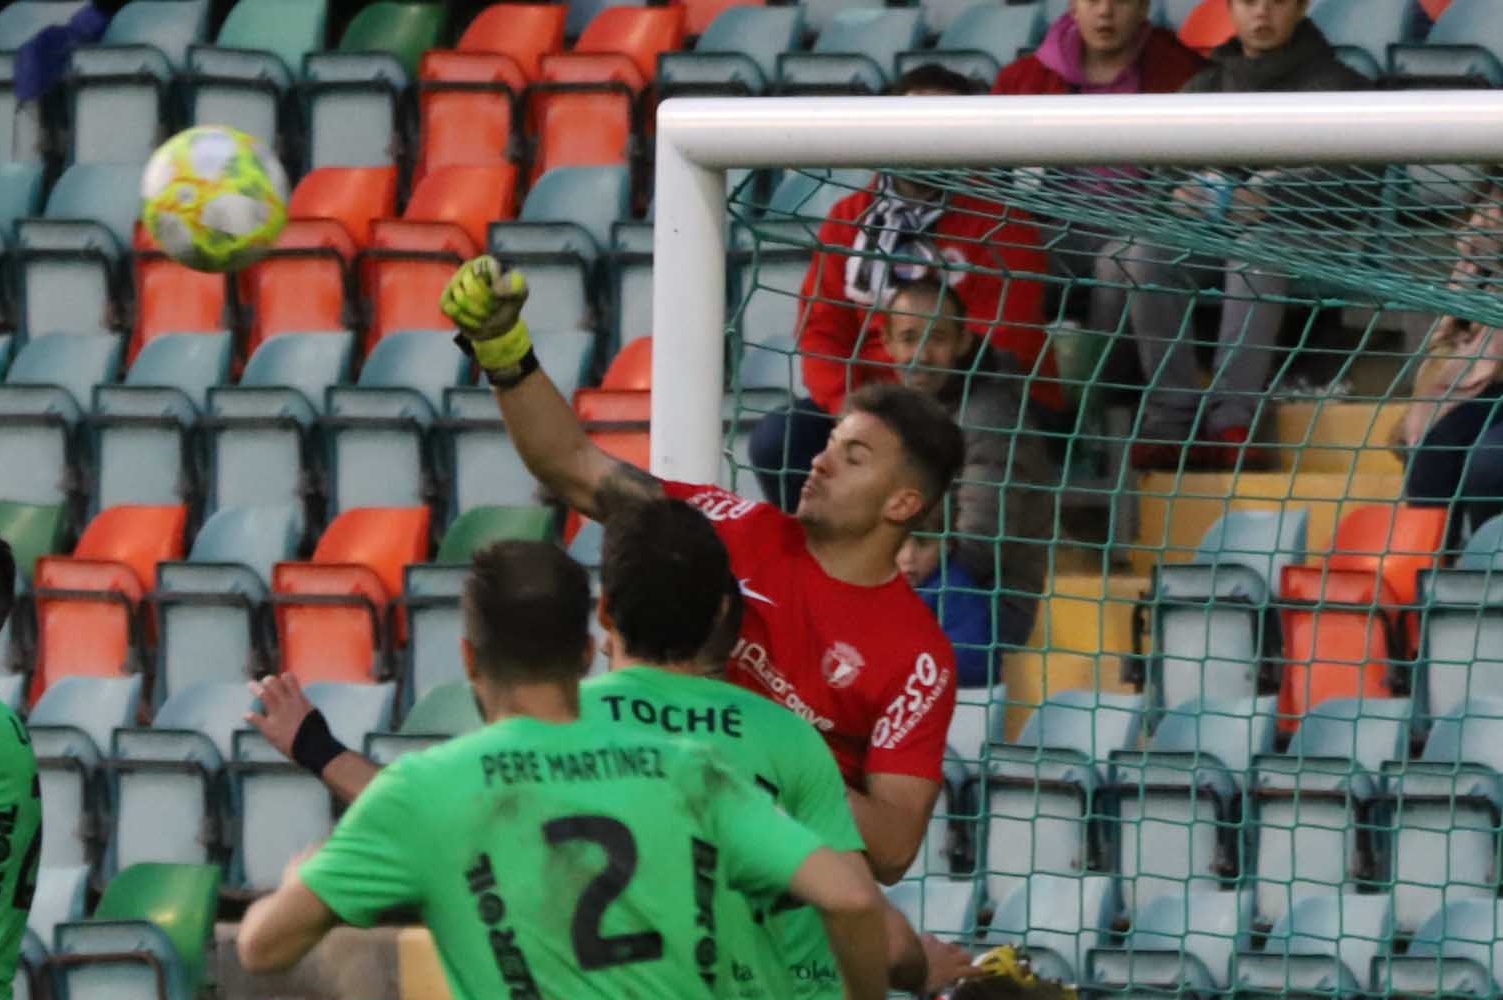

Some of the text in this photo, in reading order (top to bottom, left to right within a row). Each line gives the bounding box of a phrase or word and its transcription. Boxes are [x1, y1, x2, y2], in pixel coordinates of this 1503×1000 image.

[602, 695, 742, 737] TOCHÉ
[481, 749, 543, 787] PERE
[542, 814, 664, 971] 2
